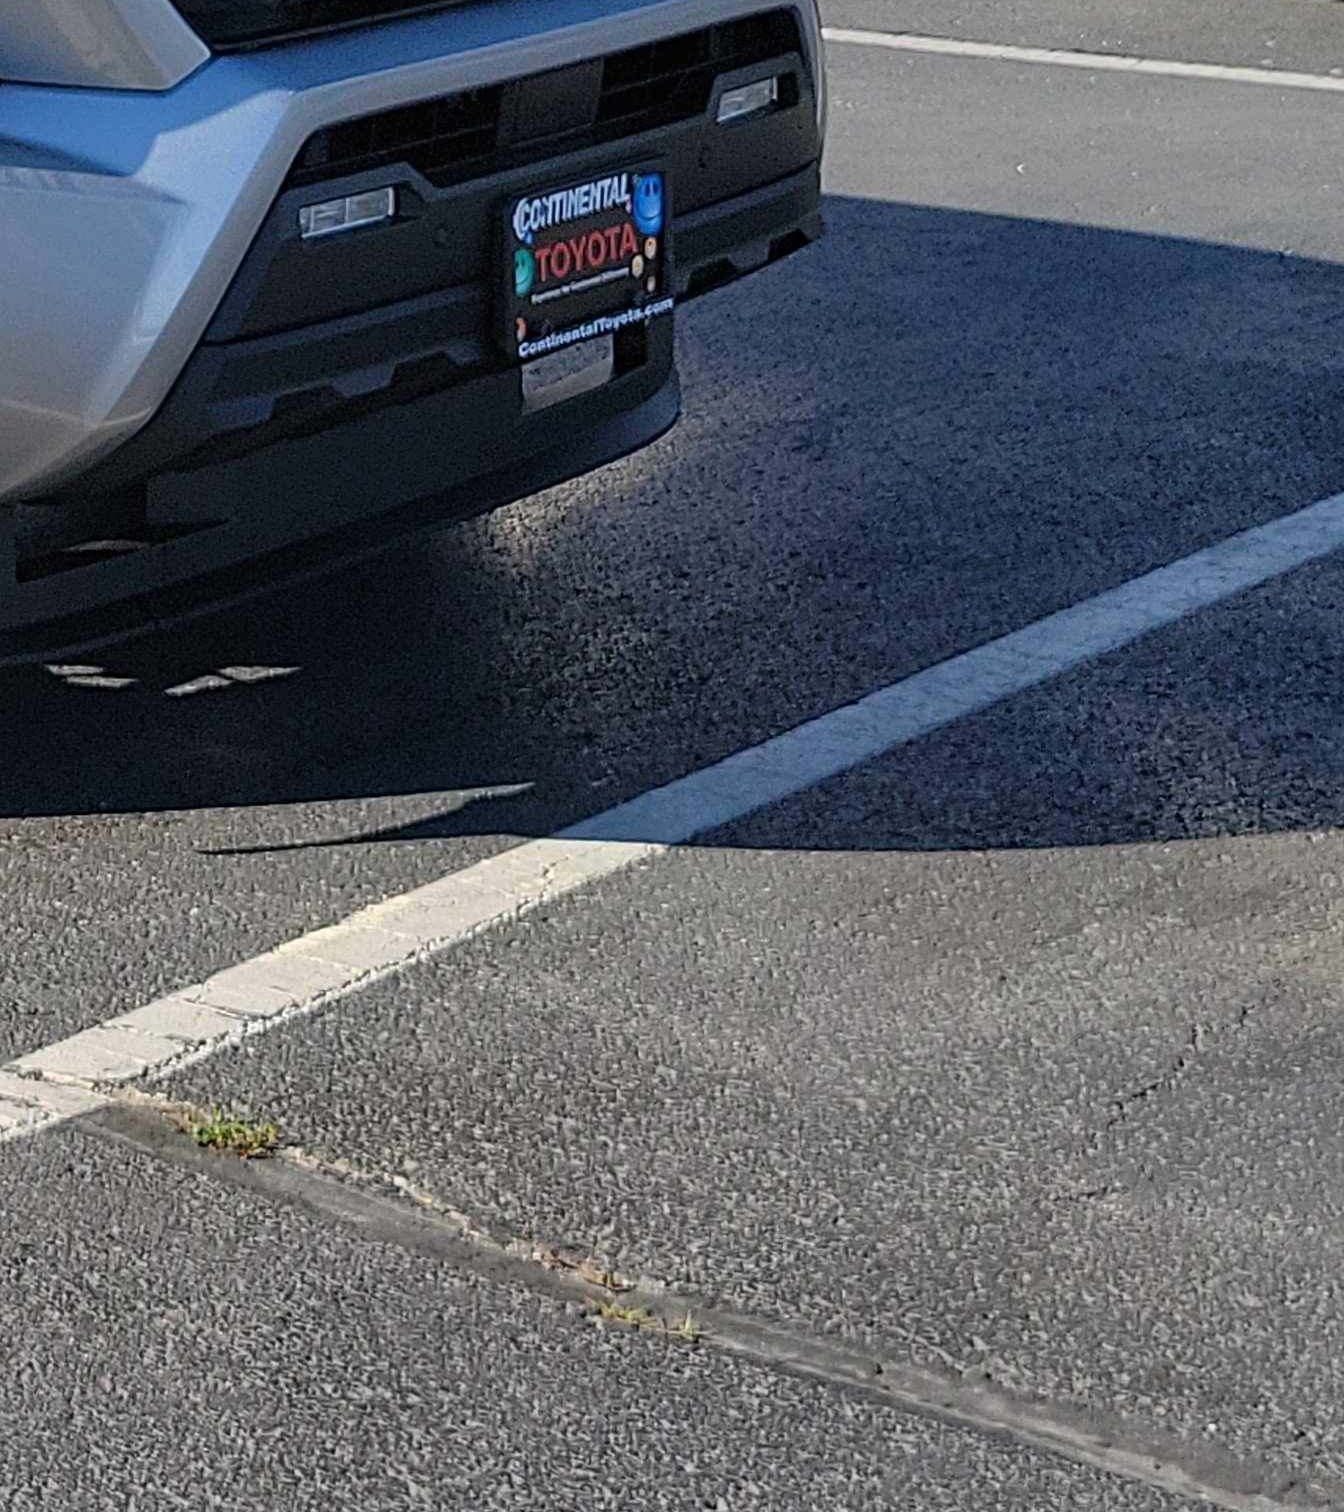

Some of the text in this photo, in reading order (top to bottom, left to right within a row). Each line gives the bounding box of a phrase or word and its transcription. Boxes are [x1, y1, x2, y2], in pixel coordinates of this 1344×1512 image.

[513, 172, 631, 241] CONTINENTAL
[535, 222, 639, 282] TOYOTA
[518, 297, 674, 358] ContinentalToyota.com
